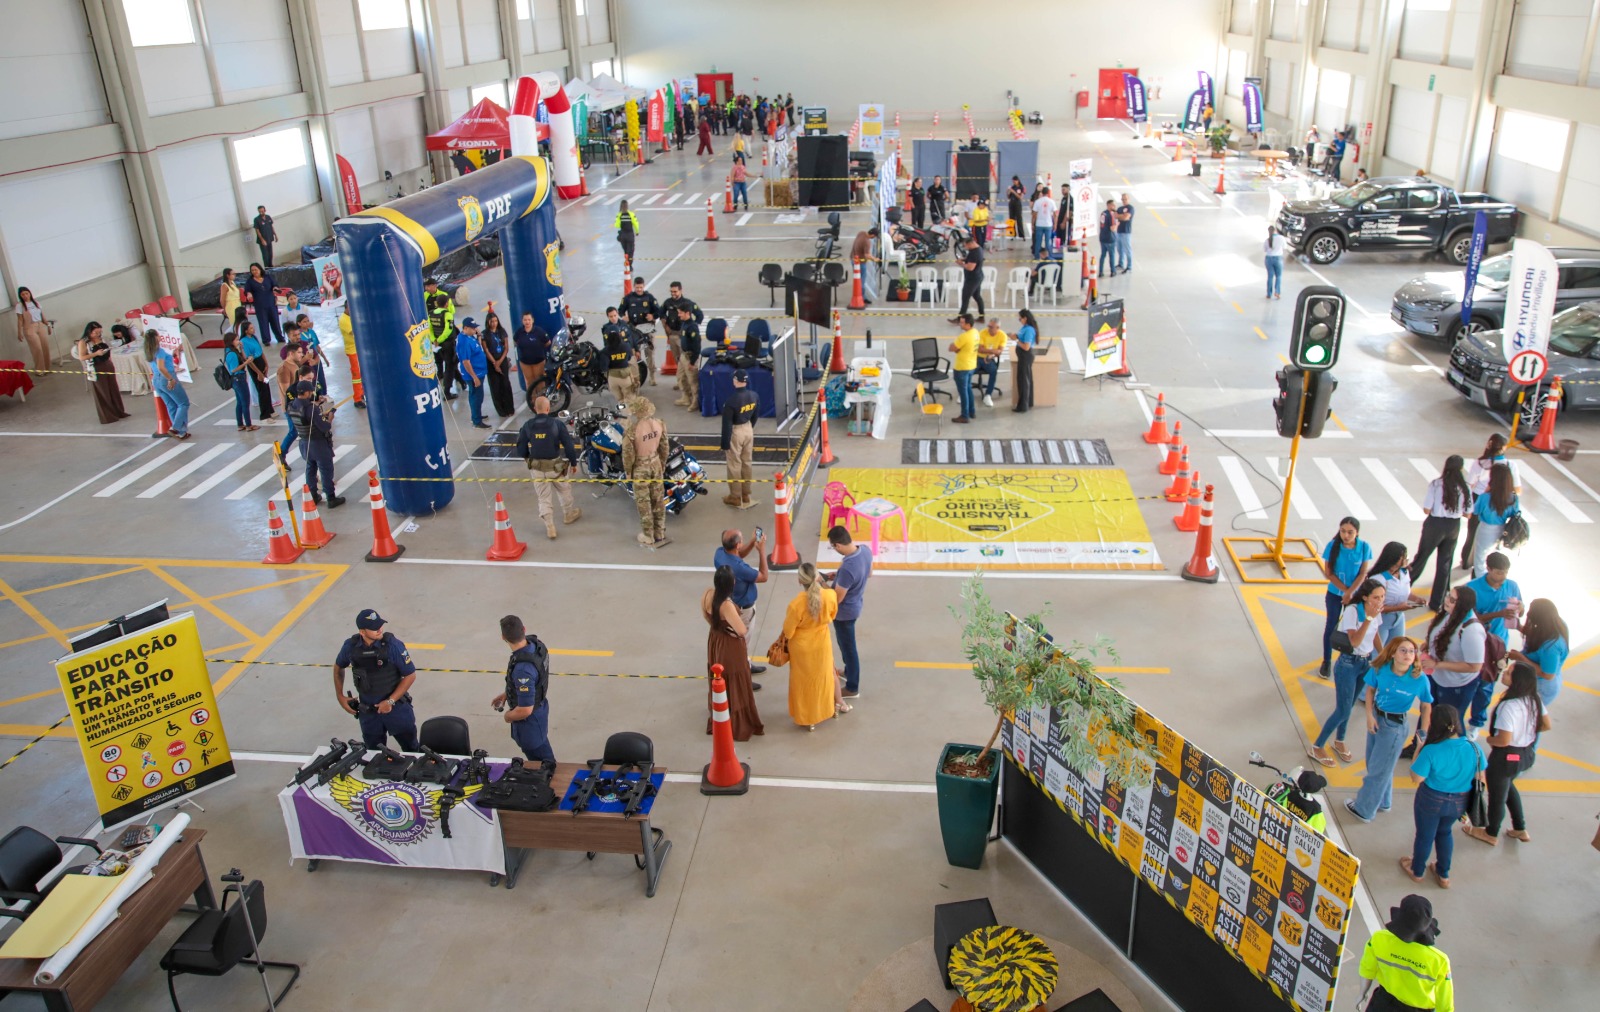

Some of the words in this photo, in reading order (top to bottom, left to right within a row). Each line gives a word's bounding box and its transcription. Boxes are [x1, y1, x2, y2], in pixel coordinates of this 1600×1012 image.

[457, 140, 498, 148] HONDA
[485, 193, 512, 224] PRF
[1518, 267, 1535, 326] HYUNDAI
[160, 334, 180, 345] ador
[611, 352, 626, 361] PRF
[740, 402, 756, 414] PRF
[642, 430, 658, 442] PRF
[67, 634, 178, 684] EDUCAÇÃO
[72, 669, 130, 700] PARA
[134, 662, 149, 675] O
[75, 668, 174, 715] TRÂNSITO
[82, 713, 106, 726] UMA
[108, 702, 132, 716] LUTA
[134, 692, 154, 706] POR
[84, 724, 102, 734] UM
[102, 704, 150, 726] TRÂNSITO
[153, 692, 176, 706] MAIS
[86, 710, 154, 742] HUMANIZADO
[164, 692, 202, 711] SEGURO
[104, 748, 117, 758] 80
[1210, 777, 1223, 791] PARA
[1212, 770, 1228, 787] PARE
[364, 785, 395, 798] GUARDA
[1212, 786, 1226, 802] VIDA
[1236, 782, 1262, 806] ASTT
[1236, 796, 1258, 819] ASTT
[1265, 802, 1290, 828] ASTT
[1234, 808, 1256, 832] ASTT
[1262, 816, 1288, 842] ASTT
[1228, 832, 1254, 857] SALVAMOS
[1233, 826, 1252, 844] JUNTOS
[1260, 830, 1286, 854] ASTT
[1294, 825, 1320, 849] RESPEITO
[1145, 840, 1166, 862] ASTT
[1200, 846, 1220, 869] ESCOLHA
[1230, 844, 1250, 864] VIDAS
[1294, 836, 1316, 858] SALVA
[1144, 853, 1164, 874] ASTT
[1198, 858, 1203, 868] A
[1142, 864, 1162, 886] ASTT
[1220, 901, 1244, 924] ASTT
[1320, 907, 1342, 930] ASTT
[1217, 912, 1242, 937] ASTT
[1280, 924, 1300, 946] ASTT
[1214, 924, 1240, 950] ASTT
[1274, 944, 1298, 969] GENTILEZA
[1280, 958, 1288, 968] NO
[1390, 952, 1427, 970] FISCALIZAÇÃO
[1272, 958, 1294, 980] TRÂNSITO
